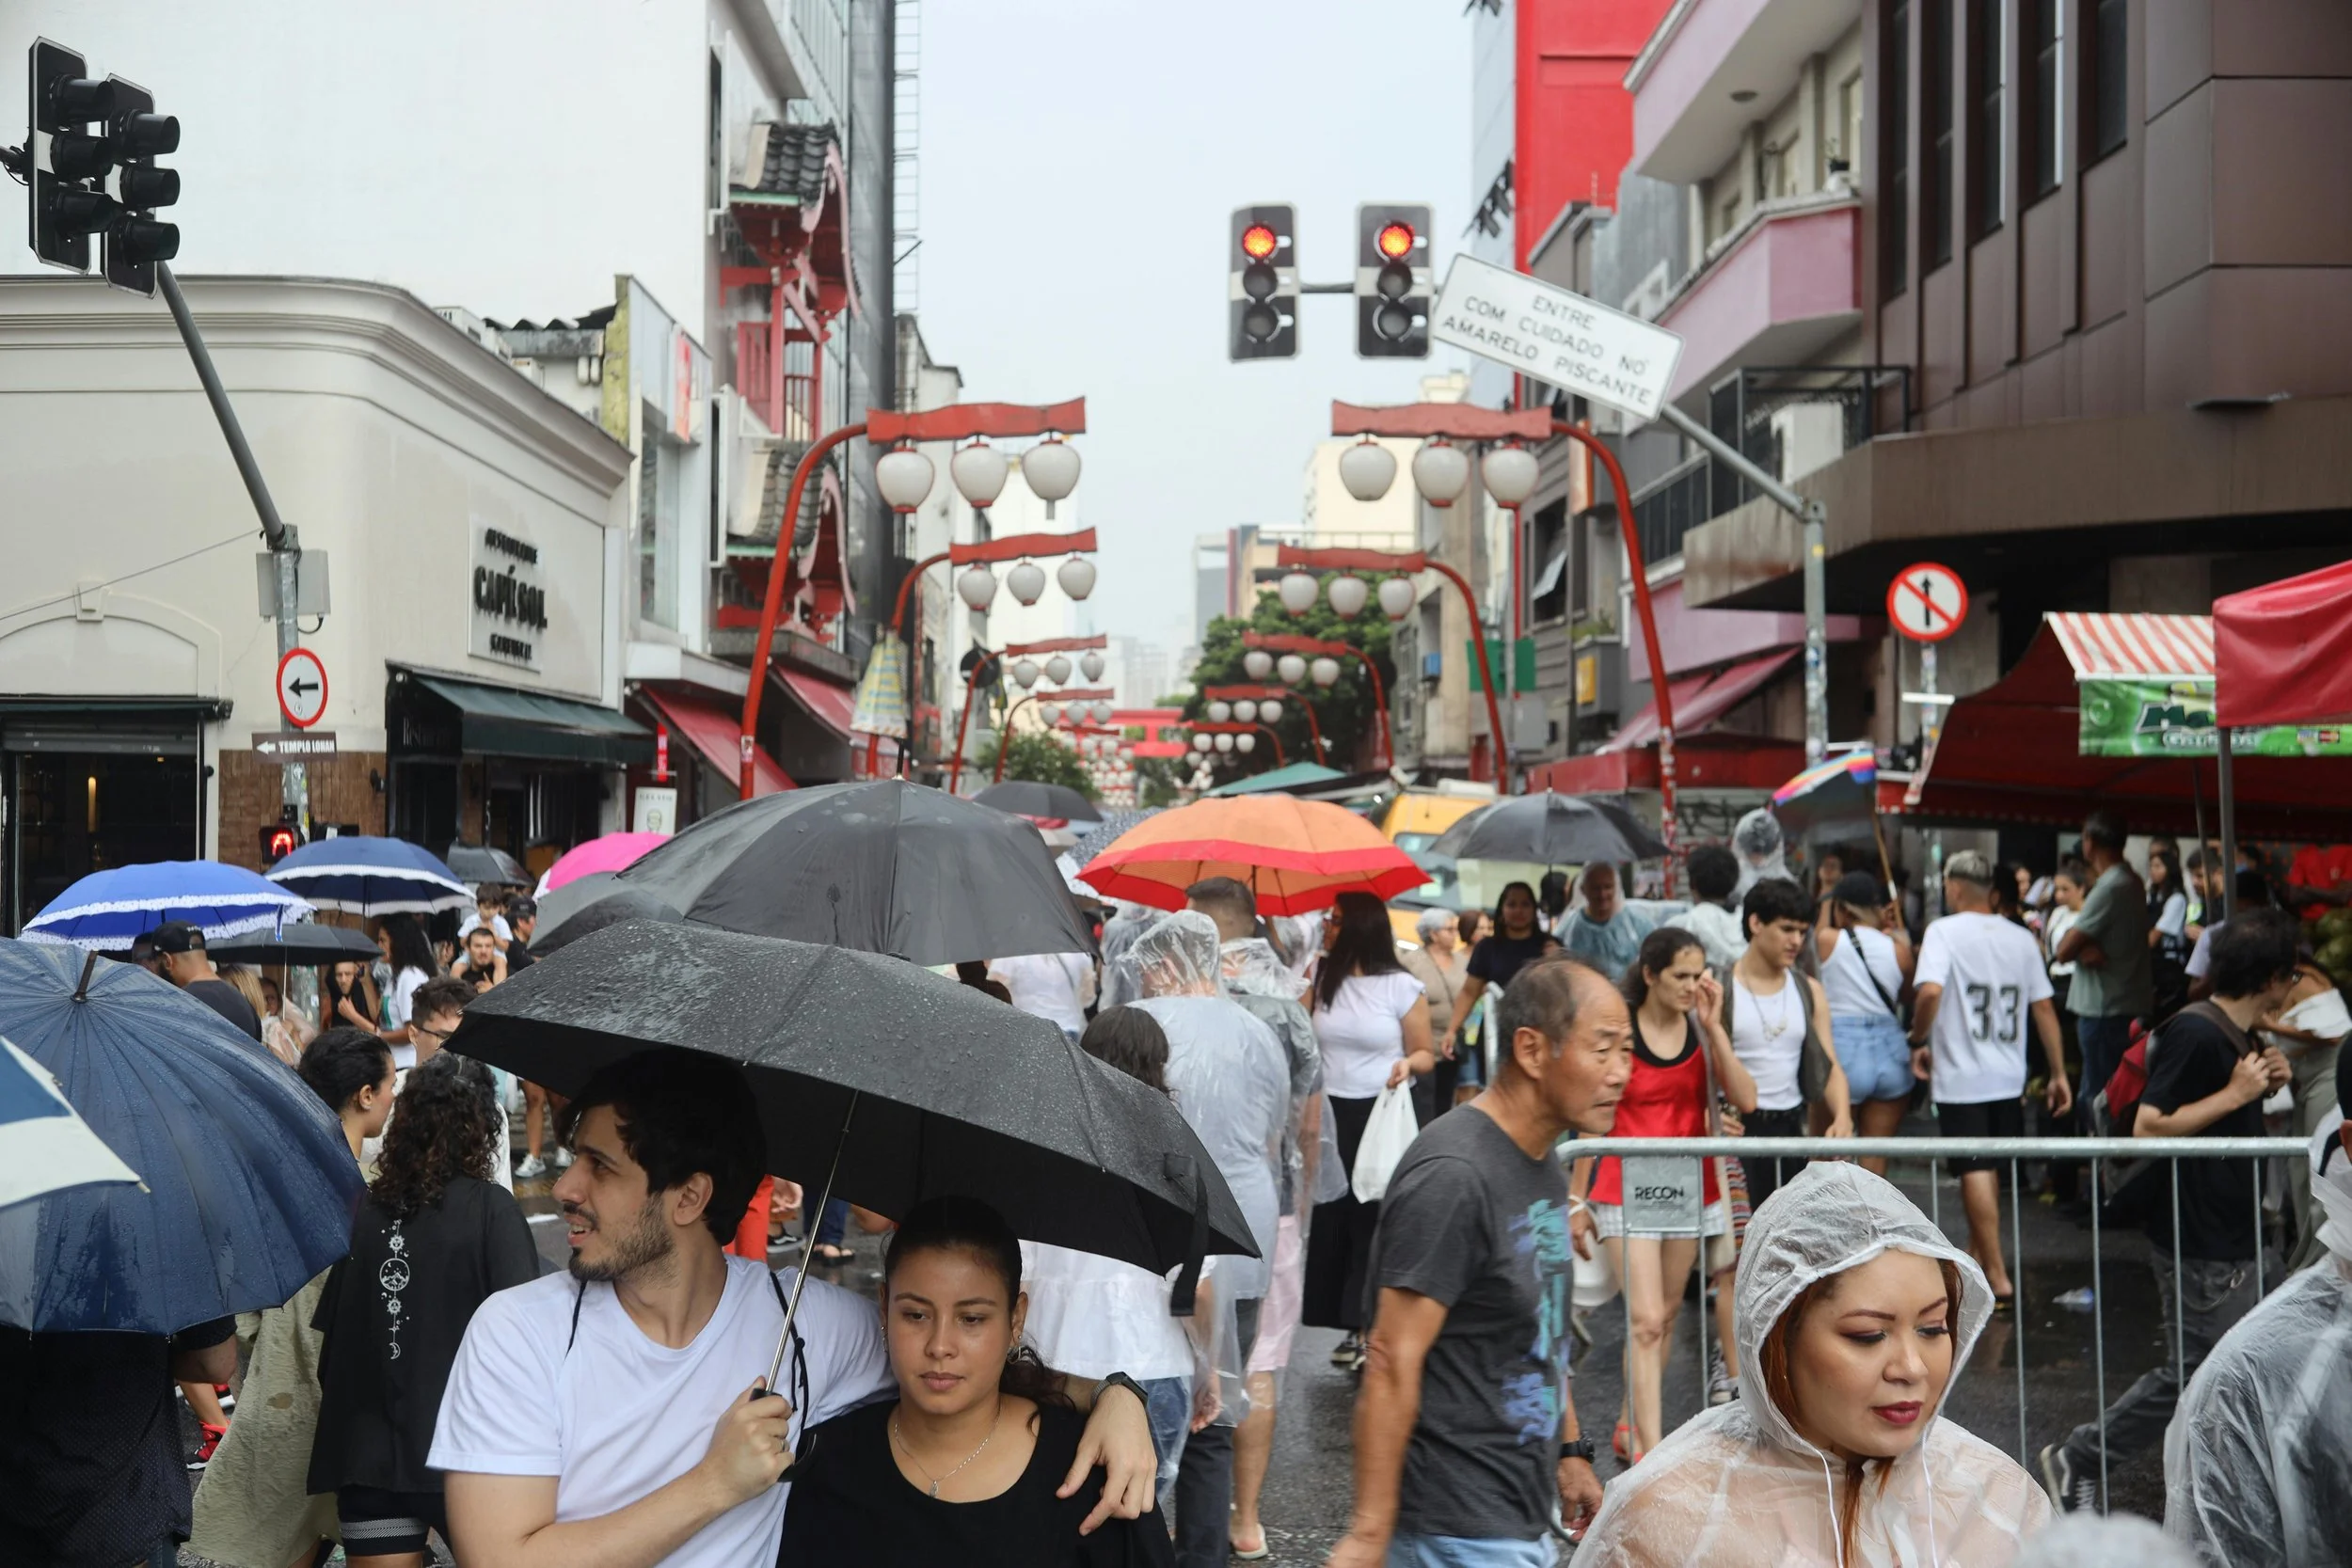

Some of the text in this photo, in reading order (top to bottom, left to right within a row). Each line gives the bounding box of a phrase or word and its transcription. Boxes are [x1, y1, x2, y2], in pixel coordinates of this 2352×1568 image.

[1464, 295, 1649, 375] COM CUIDADO NO
[1533, 294, 1596, 330] ENTRE
[1442, 315, 1654, 404] AMARELO PISCANTE
[278, 739, 335, 754] TEMPLO LOHAN
[1965, 982, 2020, 1043] 33
[1635, 1185, 1684, 1201] RECON
